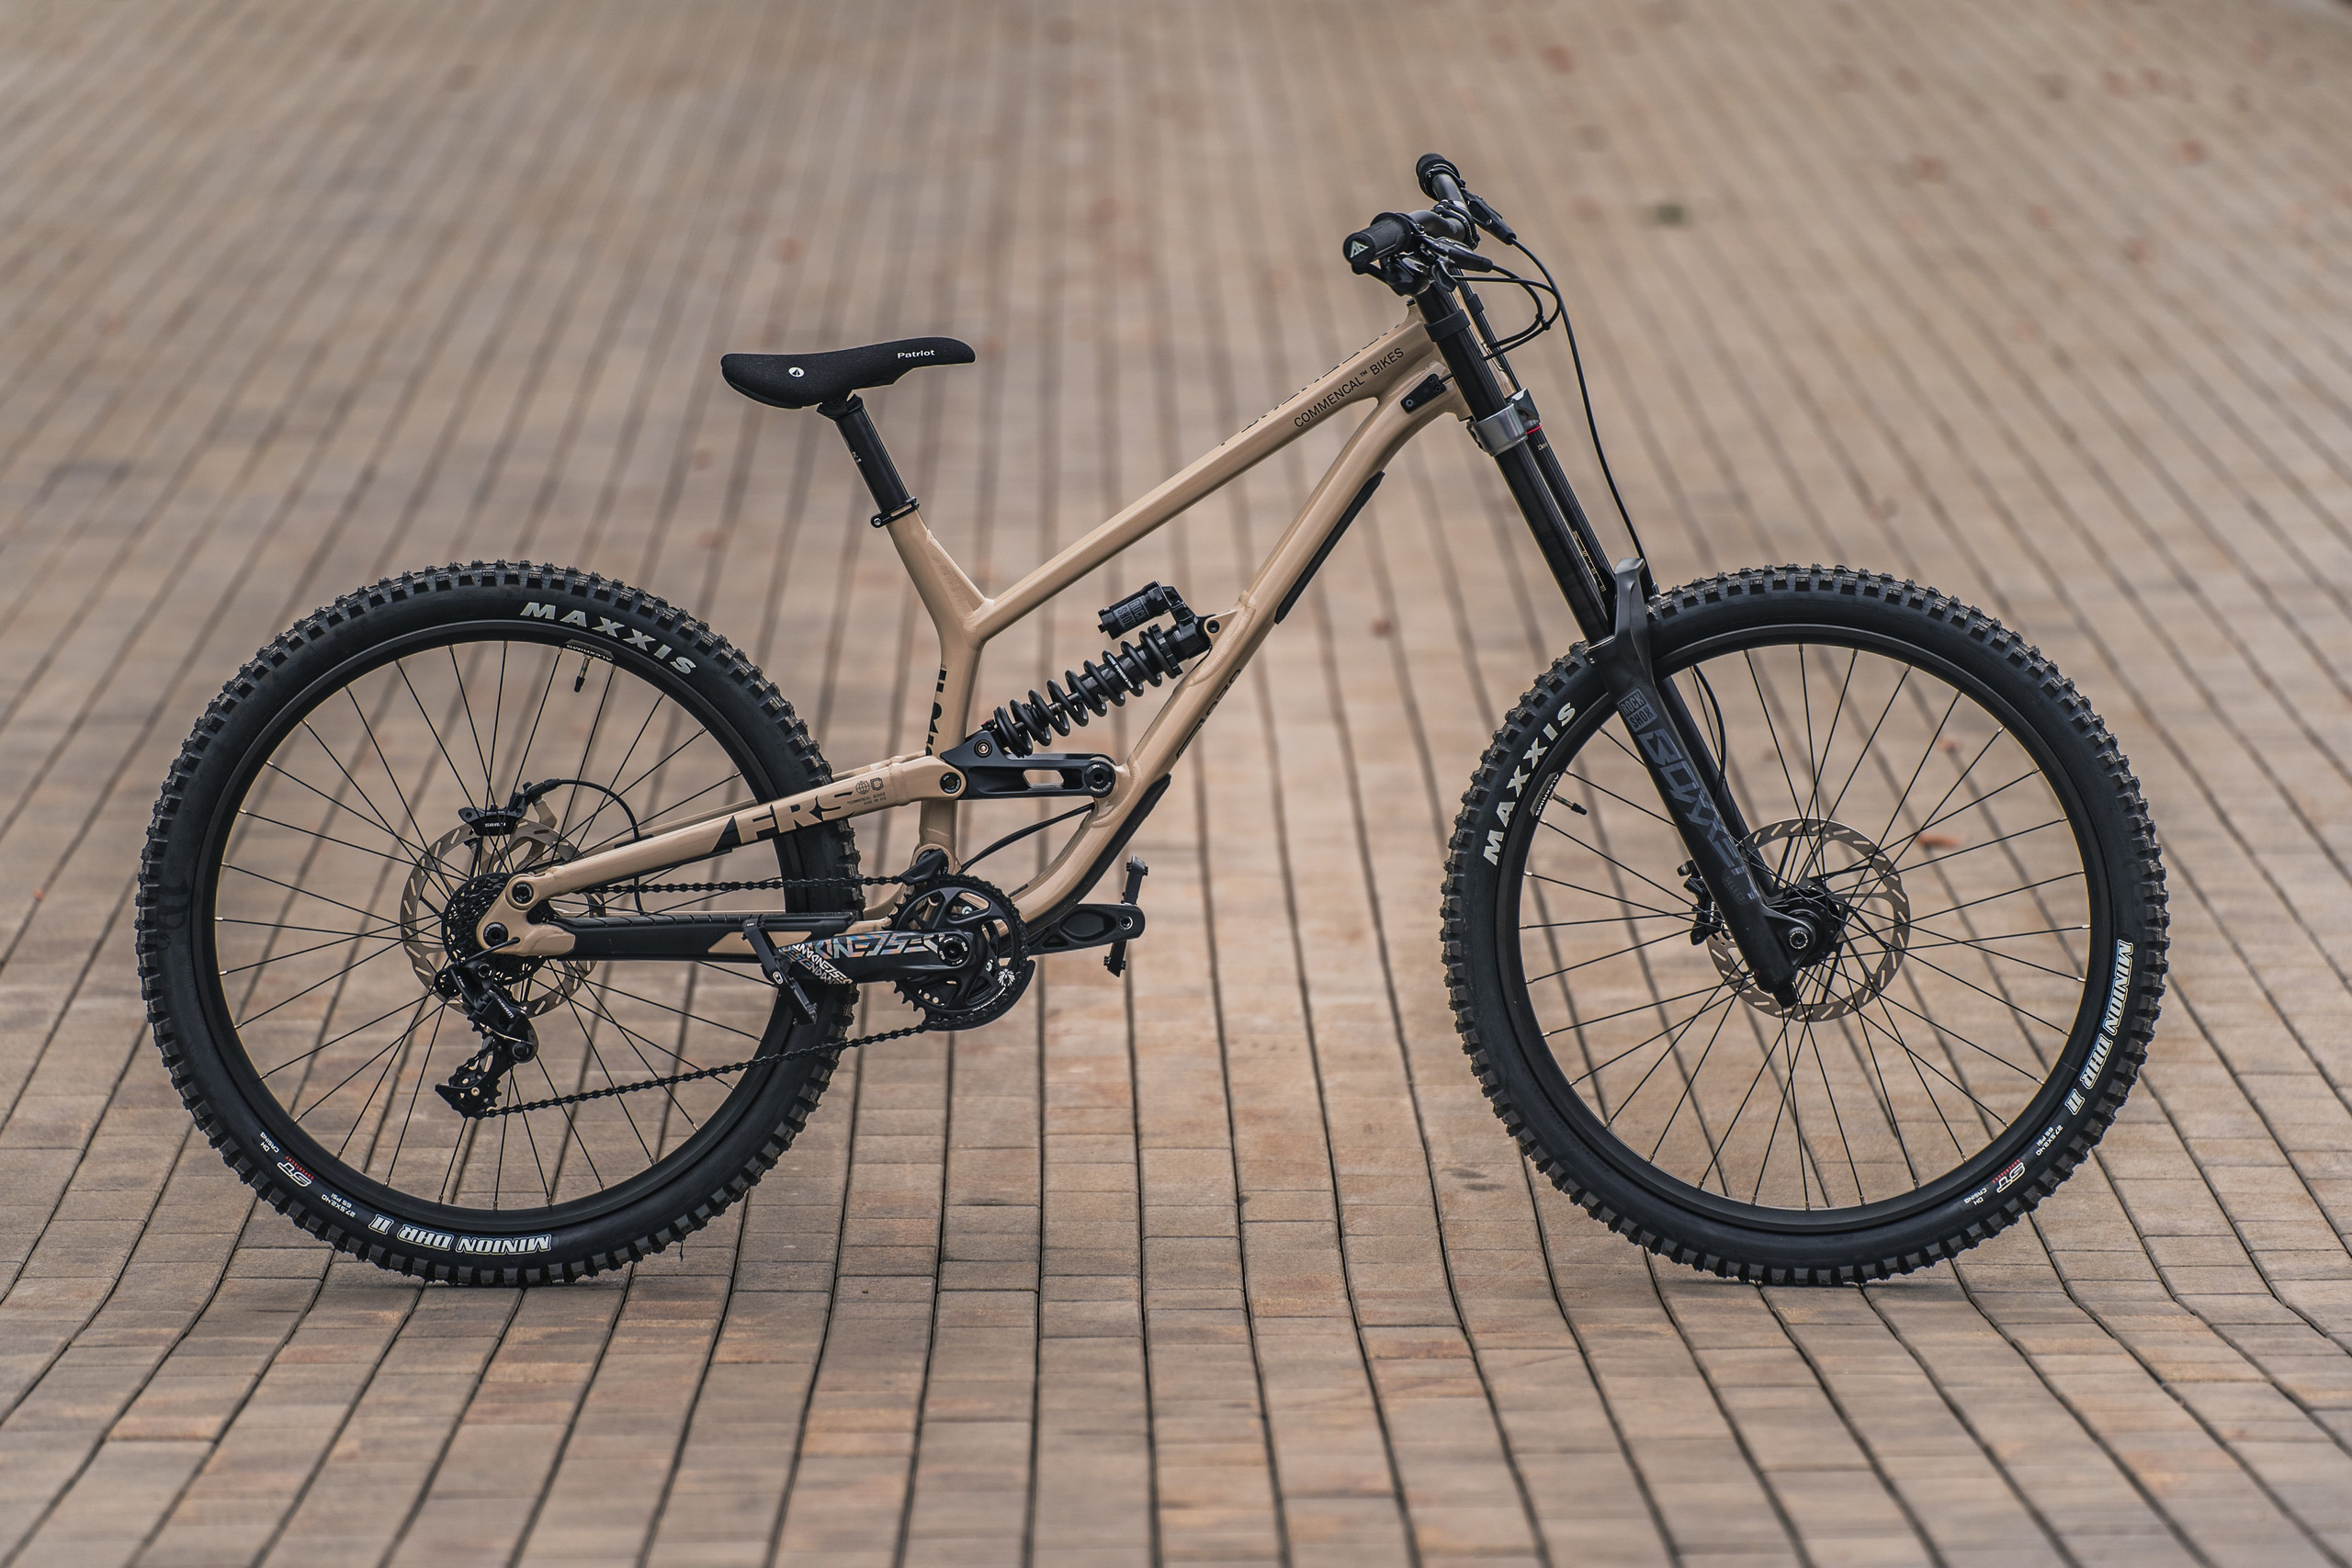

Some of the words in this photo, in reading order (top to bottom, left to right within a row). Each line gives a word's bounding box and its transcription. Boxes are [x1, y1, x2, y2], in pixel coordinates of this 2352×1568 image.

[897, 348, 935, 359] Patriot
[1369, 347, 1404, 376] BIKES
[519, 602, 697, 674] MAXXIS
[1620, 693, 1645, 716] ROCK
[1629, 706, 1655, 728] SHOX
[1483, 702, 1576, 866] MAXXIS
[1724, 875, 1746, 904] SELECT
[2102, 939, 2133, 1036] MINION
[2079, 1032, 2113, 1090] DHR
[2064, 1088, 2086, 1116] II
[259, 1131, 279, 1153] CASING
[260, 1141, 270, 1152] DH
[2036, 1135, 2047, 1146] PSI
[277, 1162, 312, 1187] ST
[1996, 1161, 2026, 1193] ST
[331, 1193, 342, 1202] PSI
[1963, 1187, 1987, 1204] CASING
[1973, 1196, 1984, 1206] DH
[368, 1213, 394, 1235] II
[397, 1224, 455, 1251] DHR
[456, 1234, 551, 1255] MINION
